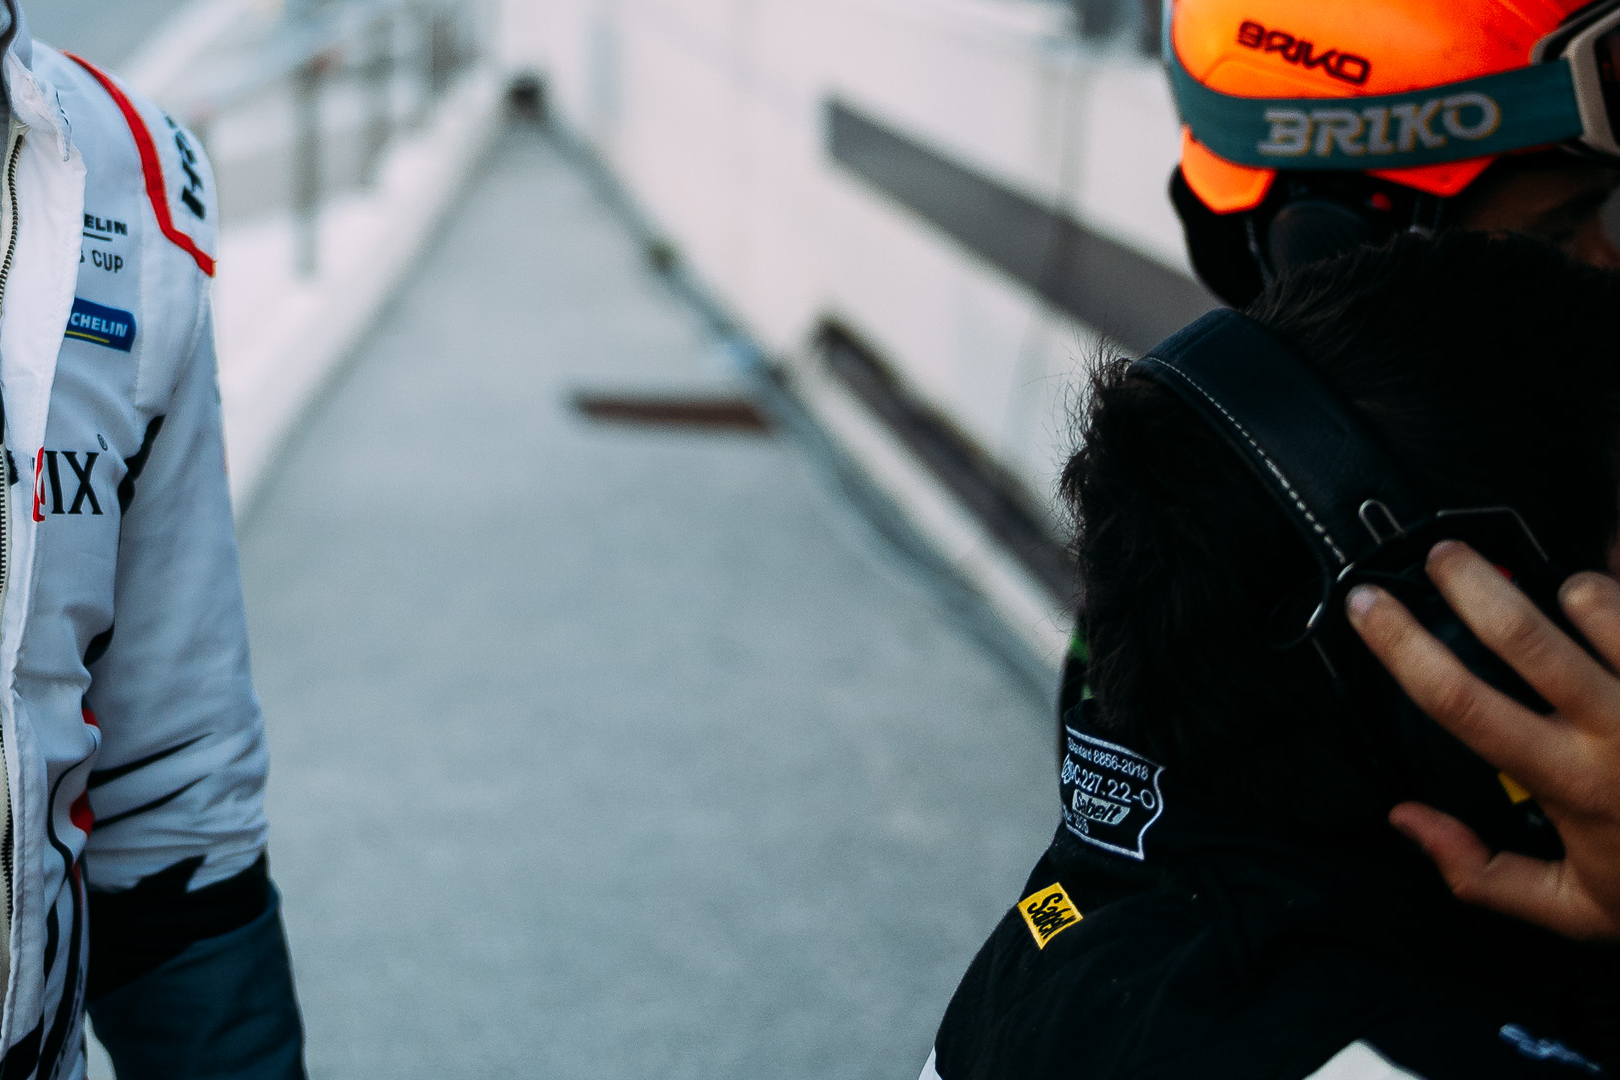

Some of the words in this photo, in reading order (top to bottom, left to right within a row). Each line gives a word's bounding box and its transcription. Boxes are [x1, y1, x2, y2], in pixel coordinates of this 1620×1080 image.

[1237, 21, 1371, 86] BRIKO
[1257, 91, 1501, 157] BRIKO
[84, 213, 128, 236] ELIN
[91, 249, 123, 274] CUP
[70, 311, 128, 338] CHELIN
[1093, 749, 1149, 781] 8856-2018
